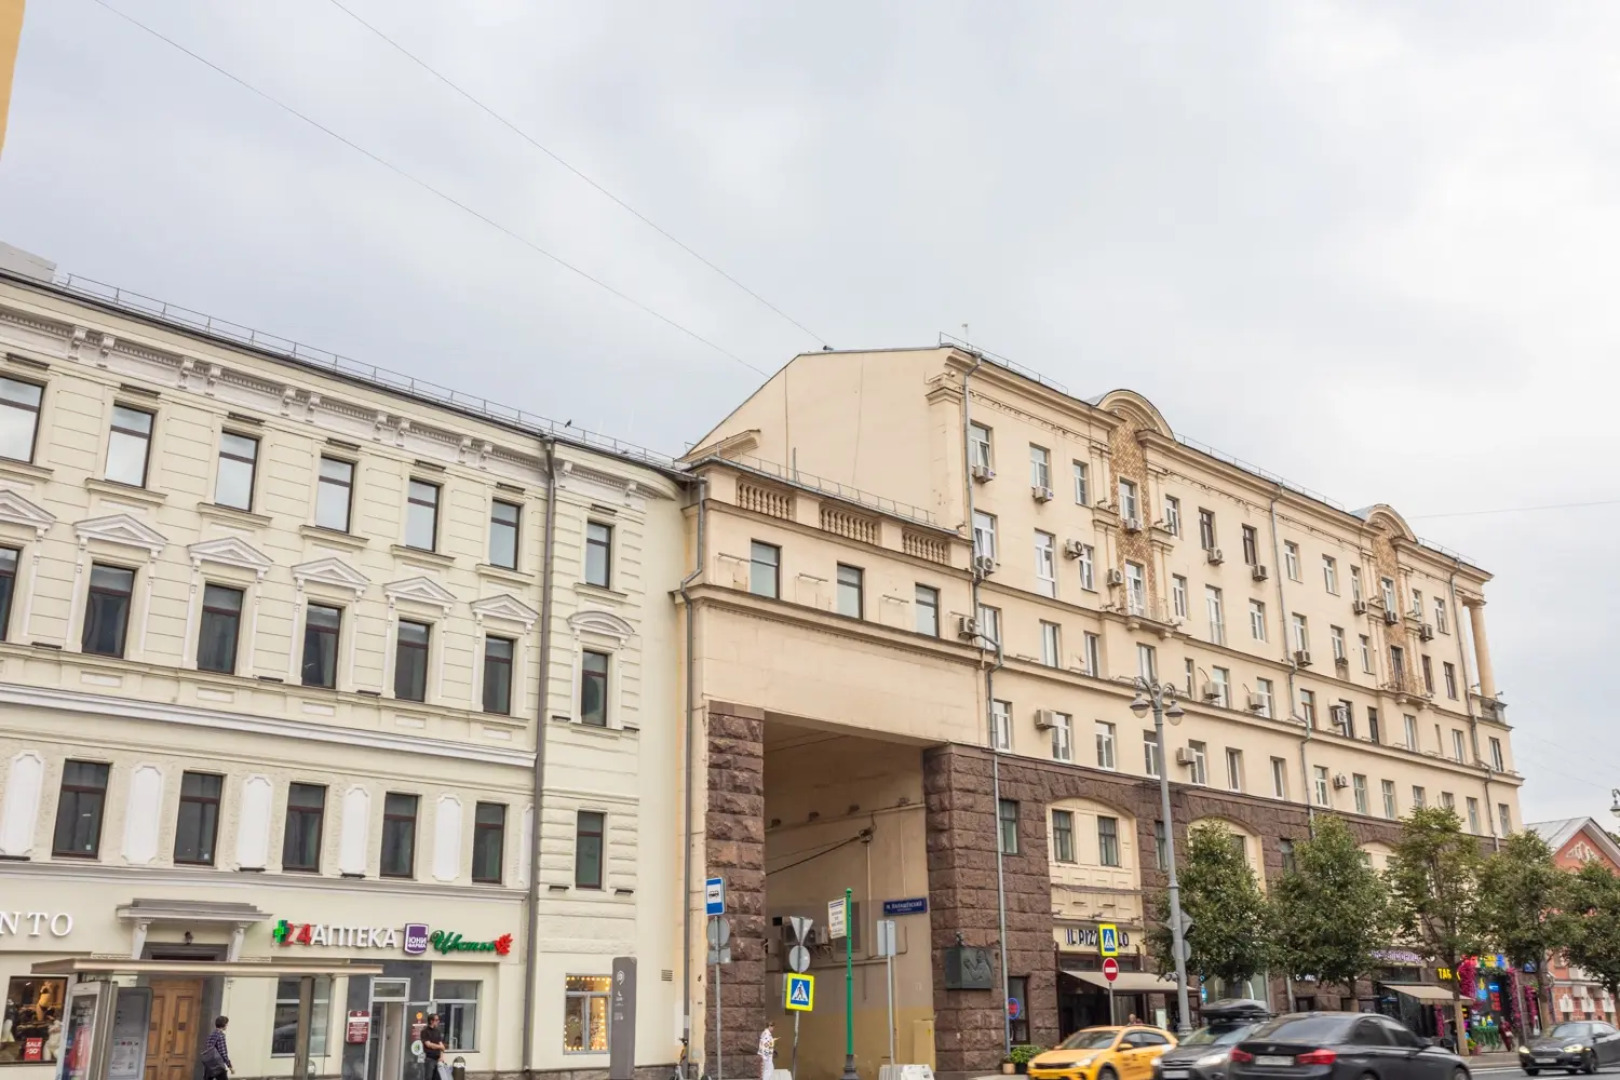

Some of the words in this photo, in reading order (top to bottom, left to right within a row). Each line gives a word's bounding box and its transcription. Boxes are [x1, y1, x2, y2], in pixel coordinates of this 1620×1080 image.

[283, 923, 311, 947] 24
[311, 923, 397, 948] АПТЕКА
[408, 936, 427, 945] ЮНИ
[1066, 929, 1077, 945] IL
[1078, 929, 1129, 947] PIZZLO
